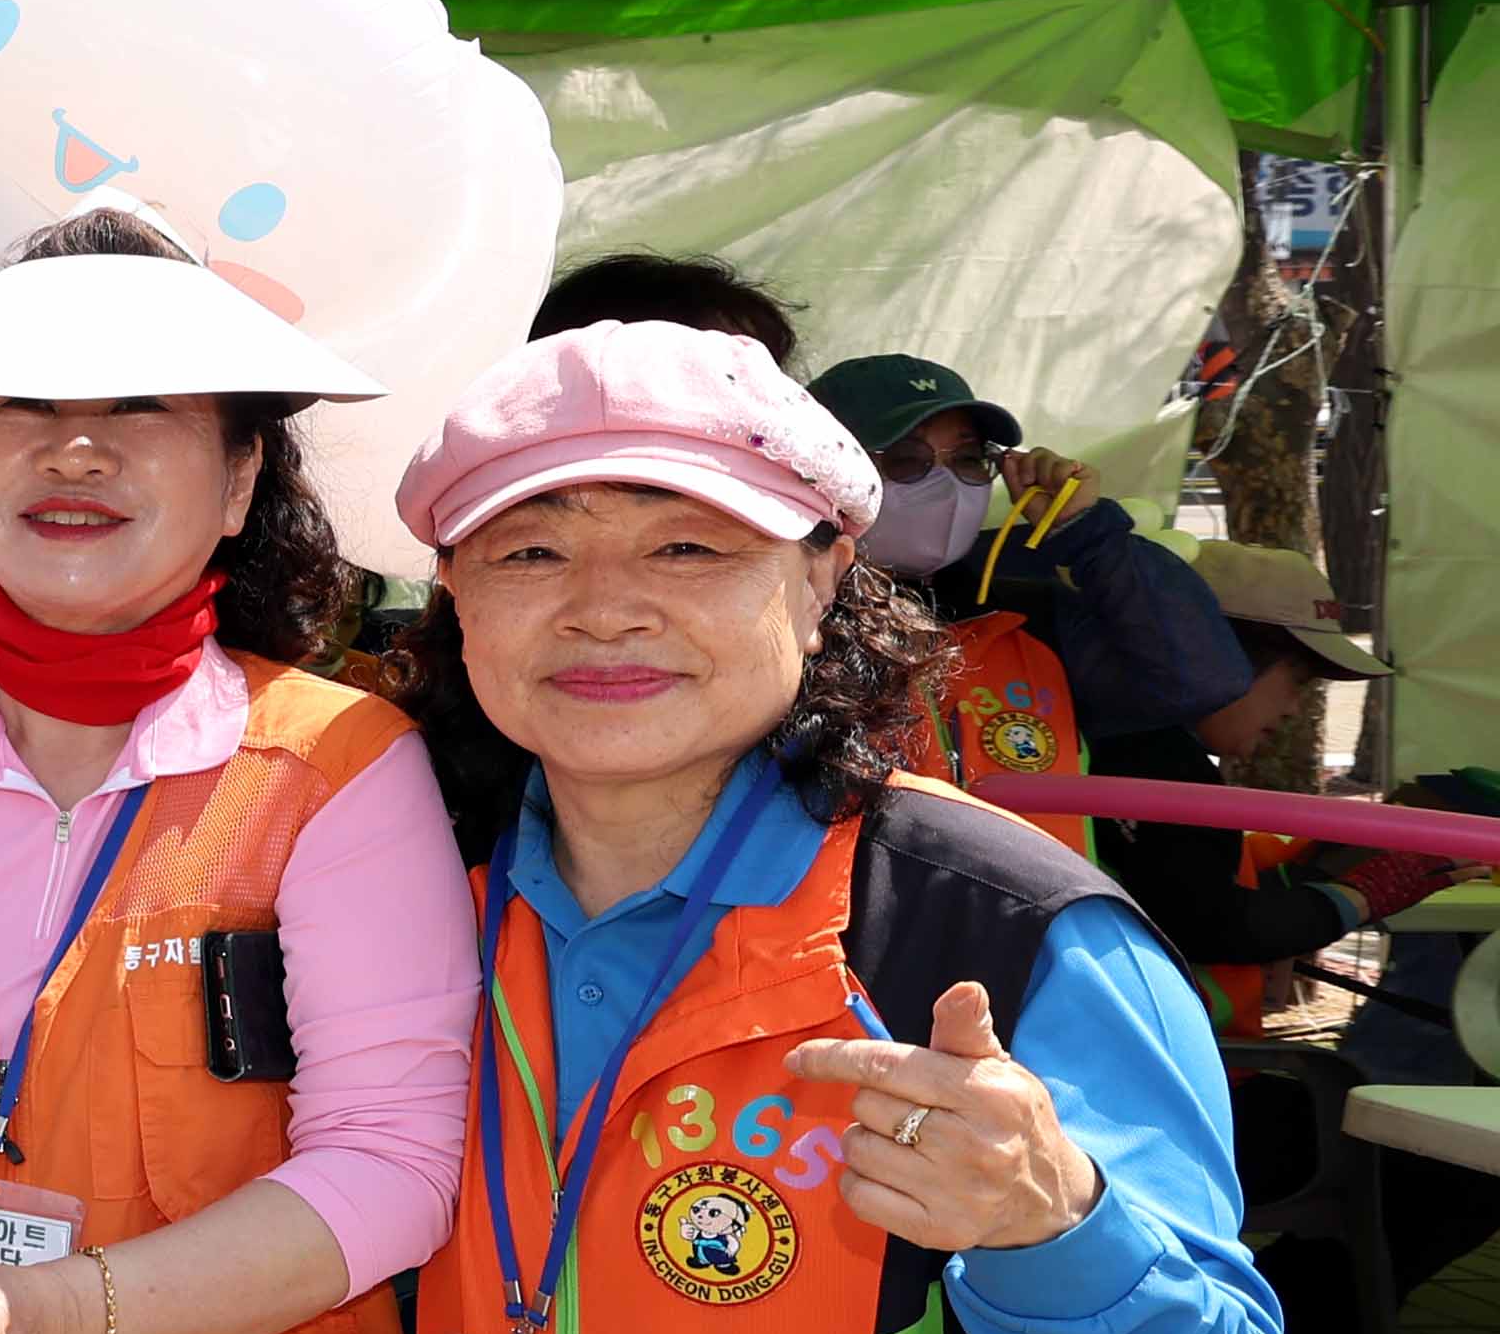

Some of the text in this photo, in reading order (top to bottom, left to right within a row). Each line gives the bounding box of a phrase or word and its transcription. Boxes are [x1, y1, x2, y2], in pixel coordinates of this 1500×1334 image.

[630, 1083, 846, 1191] 1365
[643, 1163, 792, 1232] 동구자원봉사센터
[642, 1237, 791, 1303] IN-CHEON DONG-GU
